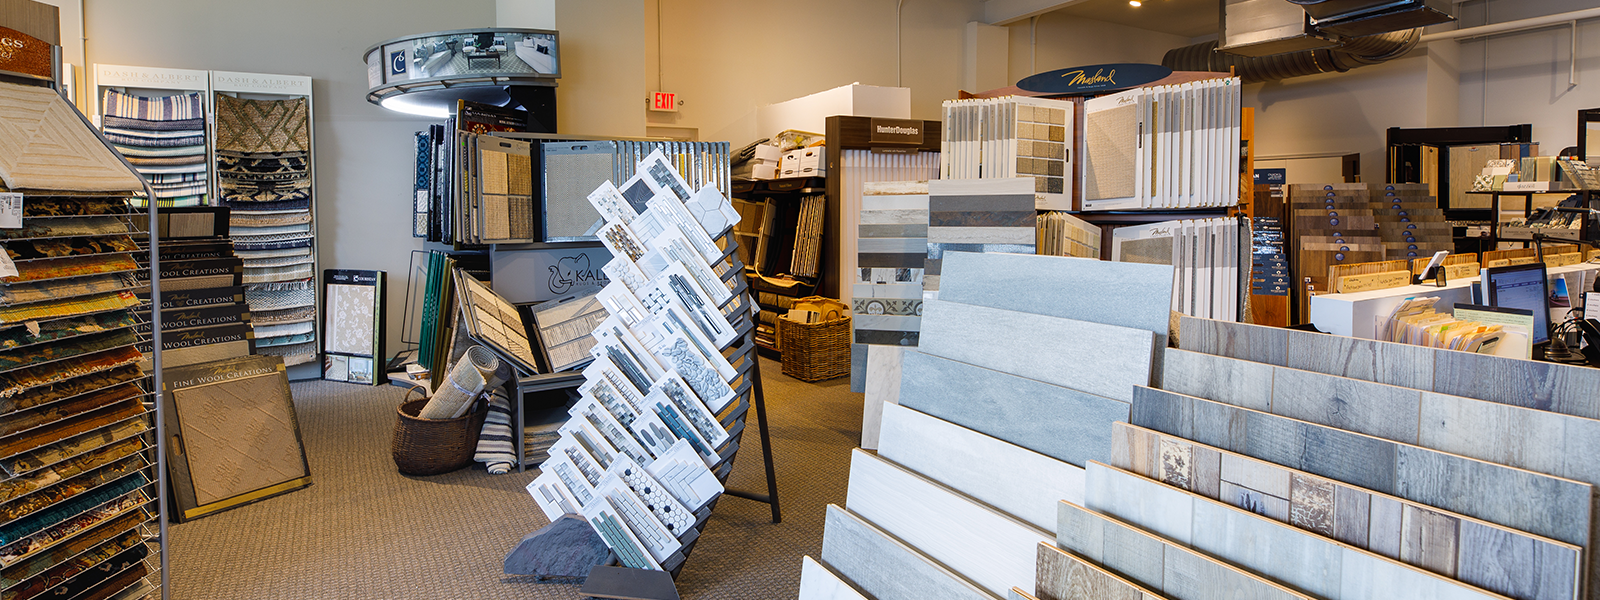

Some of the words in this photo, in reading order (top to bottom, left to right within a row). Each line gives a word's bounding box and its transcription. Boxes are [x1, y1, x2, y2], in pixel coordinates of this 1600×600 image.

[103, 70, 138, 78] DASH
[153, 73, 200, 81] ALBERT
[1061, 68, 1116, 86] Masland
[655, 92, 675, 110] EXIT
[182, 267, 230, 276] CREATIONS
[186, 295, 233, 306] CREATIONS
[190, 315, 237, 326] CREATIONS
[163, 340, 192, 349] WOOL
[193, 334, 242, 346] CREATIONS
[173, 379, 194, 388] FINE
[197, 375, 224, 384] WOOL
[226, 367, 273, 379] CREATIONS
